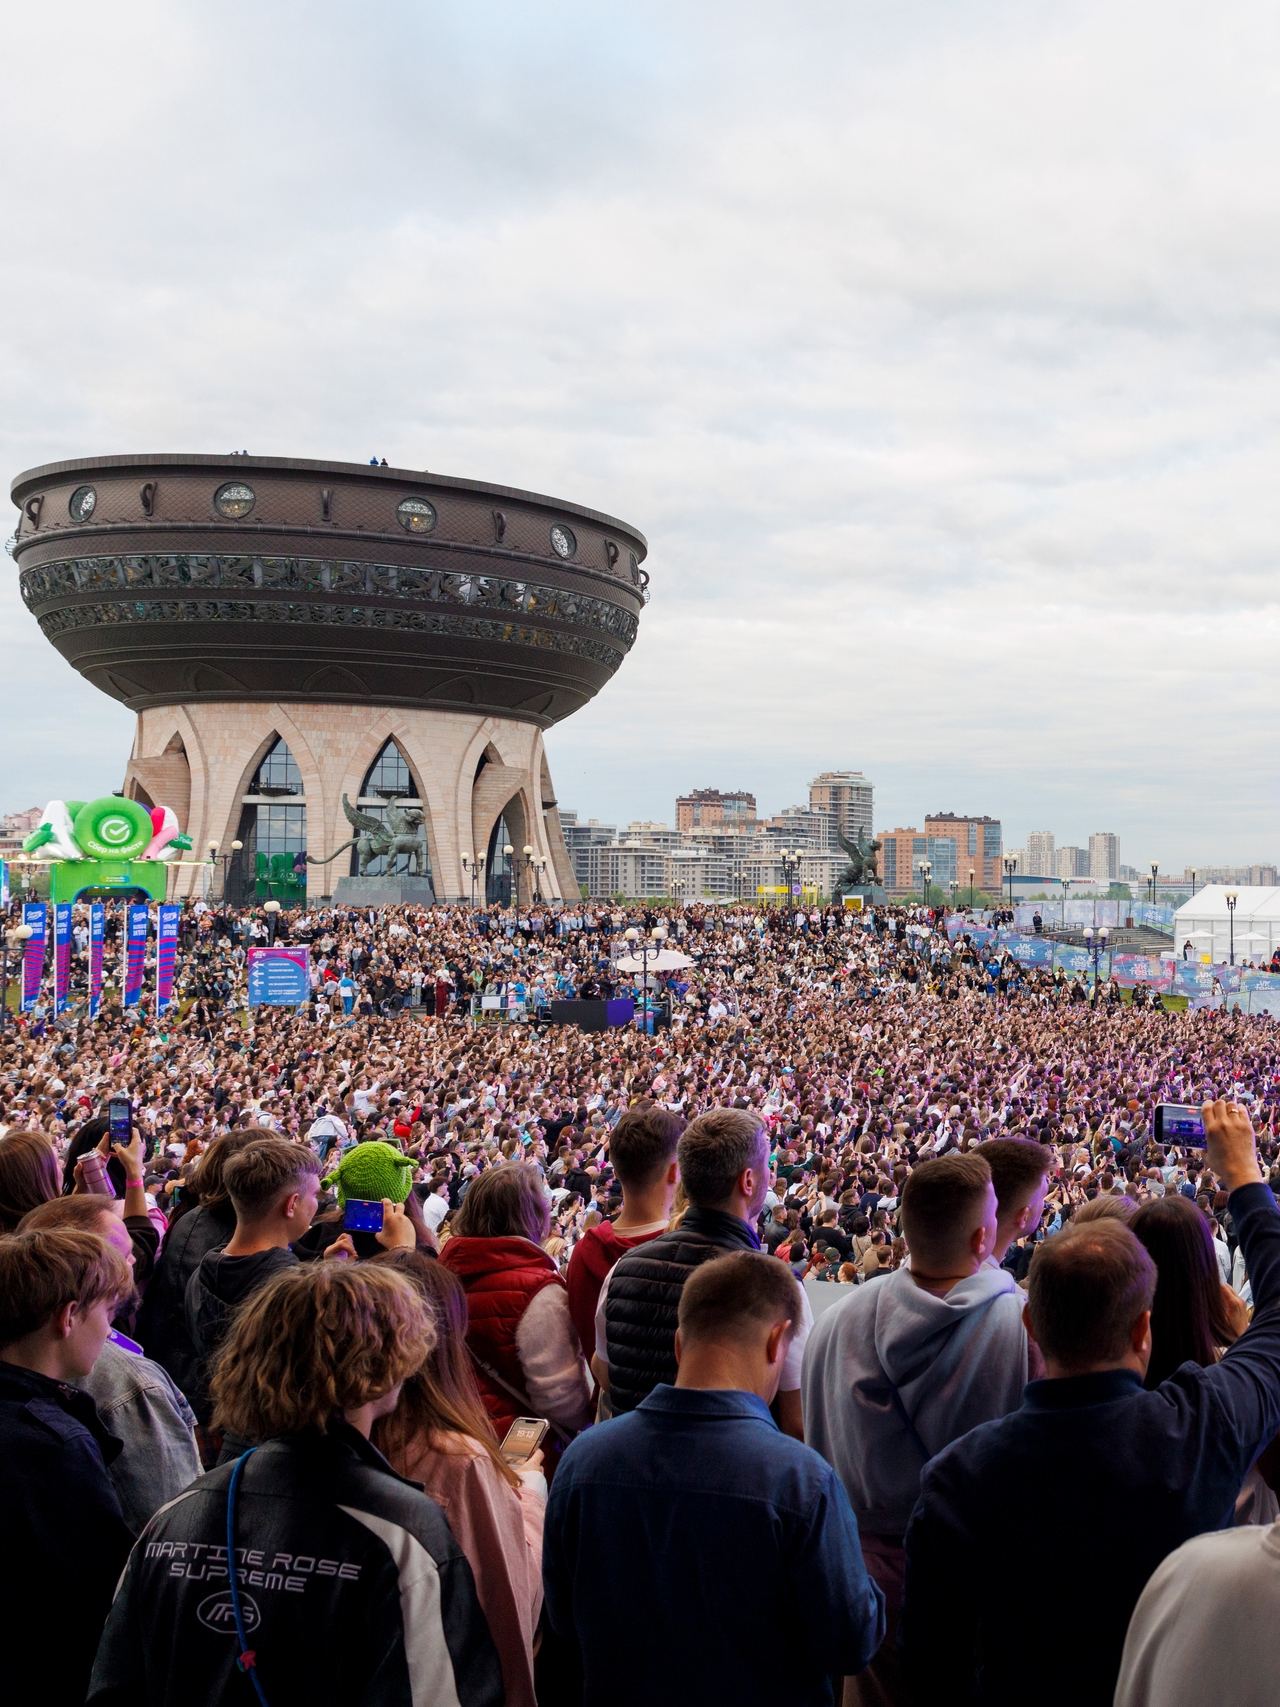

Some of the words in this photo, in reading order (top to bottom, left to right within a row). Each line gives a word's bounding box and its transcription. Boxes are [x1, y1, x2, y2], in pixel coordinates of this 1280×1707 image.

[87, 840, 107, 854] Сбер
[120, 840, 144, 854] фесте
[517, 1430, 534, 1438] 19:13
[272, 1552, 362, 1581] ROSE
[170, 1562, 308, 1593] SUPREME
